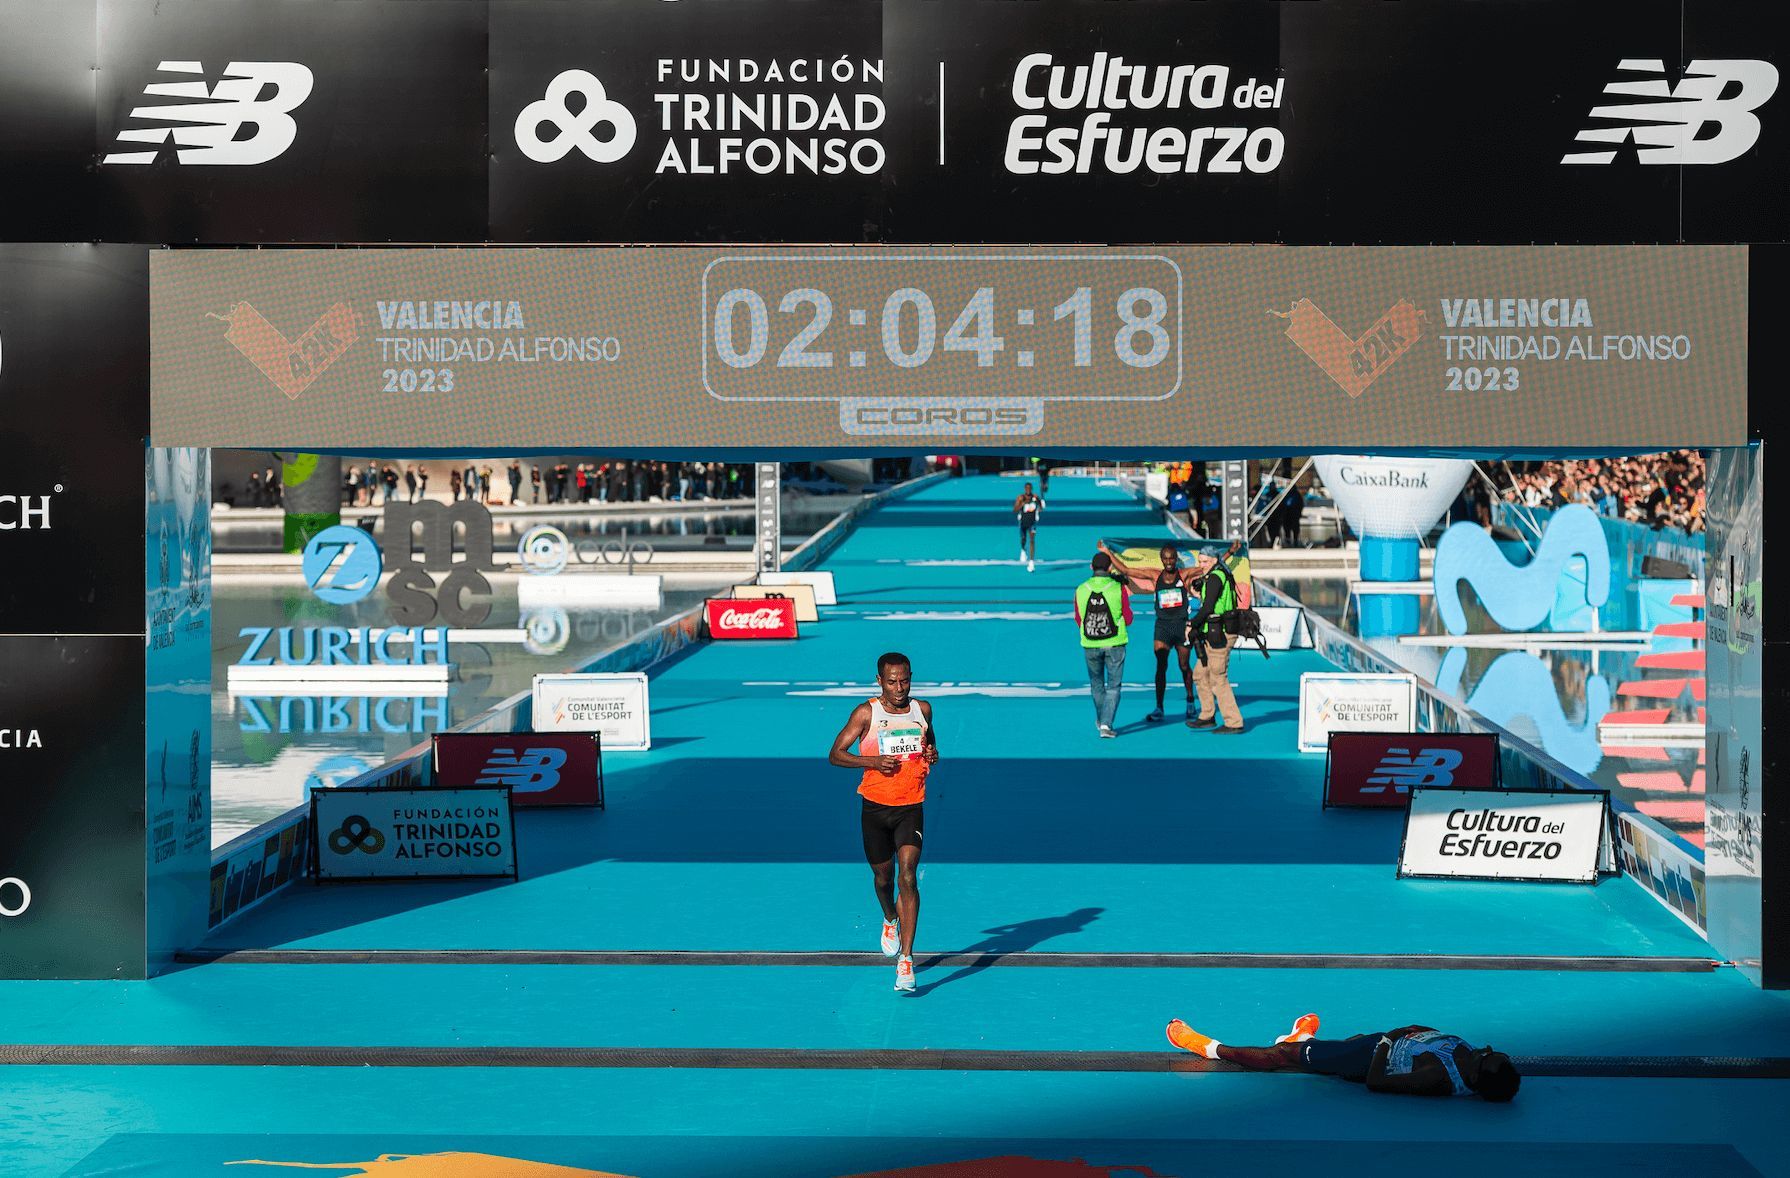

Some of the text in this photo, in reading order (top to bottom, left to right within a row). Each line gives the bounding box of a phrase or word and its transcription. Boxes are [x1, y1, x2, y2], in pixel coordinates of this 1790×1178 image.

[657, 55, 885, 83] FUNDACIÓN
[1012, 52, 1285, 109] Cultura del
[655, 94, 886, 131] TRINIDAD
[655, 138, 886, 175] ALFONSO
[1003, 112, 1285, 175] Esfuerzo
[376, 300, 525, 330] VALENCIA
[1440, 298, 1594, 328] VALENCIA
[713, 287, 1171, 369] 02:04:18
[376, 336, 621, 362] TRINIDAD ALFONSO
[1439, 334, 1691, 360] TRINIDAD ALFONSO
[382, 368, 455, 393] 2023
[1445, 366, 1520, 391] 2023
[856, 407, 1028, 425] COROS
[1339, 466, 1429, 489] CaixaBank
[573, 526, 654, 576] edp
[237, 625, 450, 666] ZURICH
[567, 703, 625, 711] COMUNITAT
[572, 711, 632, 721] DE L'ESPORT
[1333, 703, 1392, 713] COMUNITAT
[1337, 712, 1399, 721] DE L'ESPORT
[890, 744, 918, 754] BEKELE
[393, 805, 500, 820] FUNDACIÓN
[1446, 808, 1566, 835] Cultura del
[393, 823, 501, 841] TRINIDAD
[395, 841, 502, 860] ALFONSO
[1438, 832, 1563, 860] Esfuerzo
